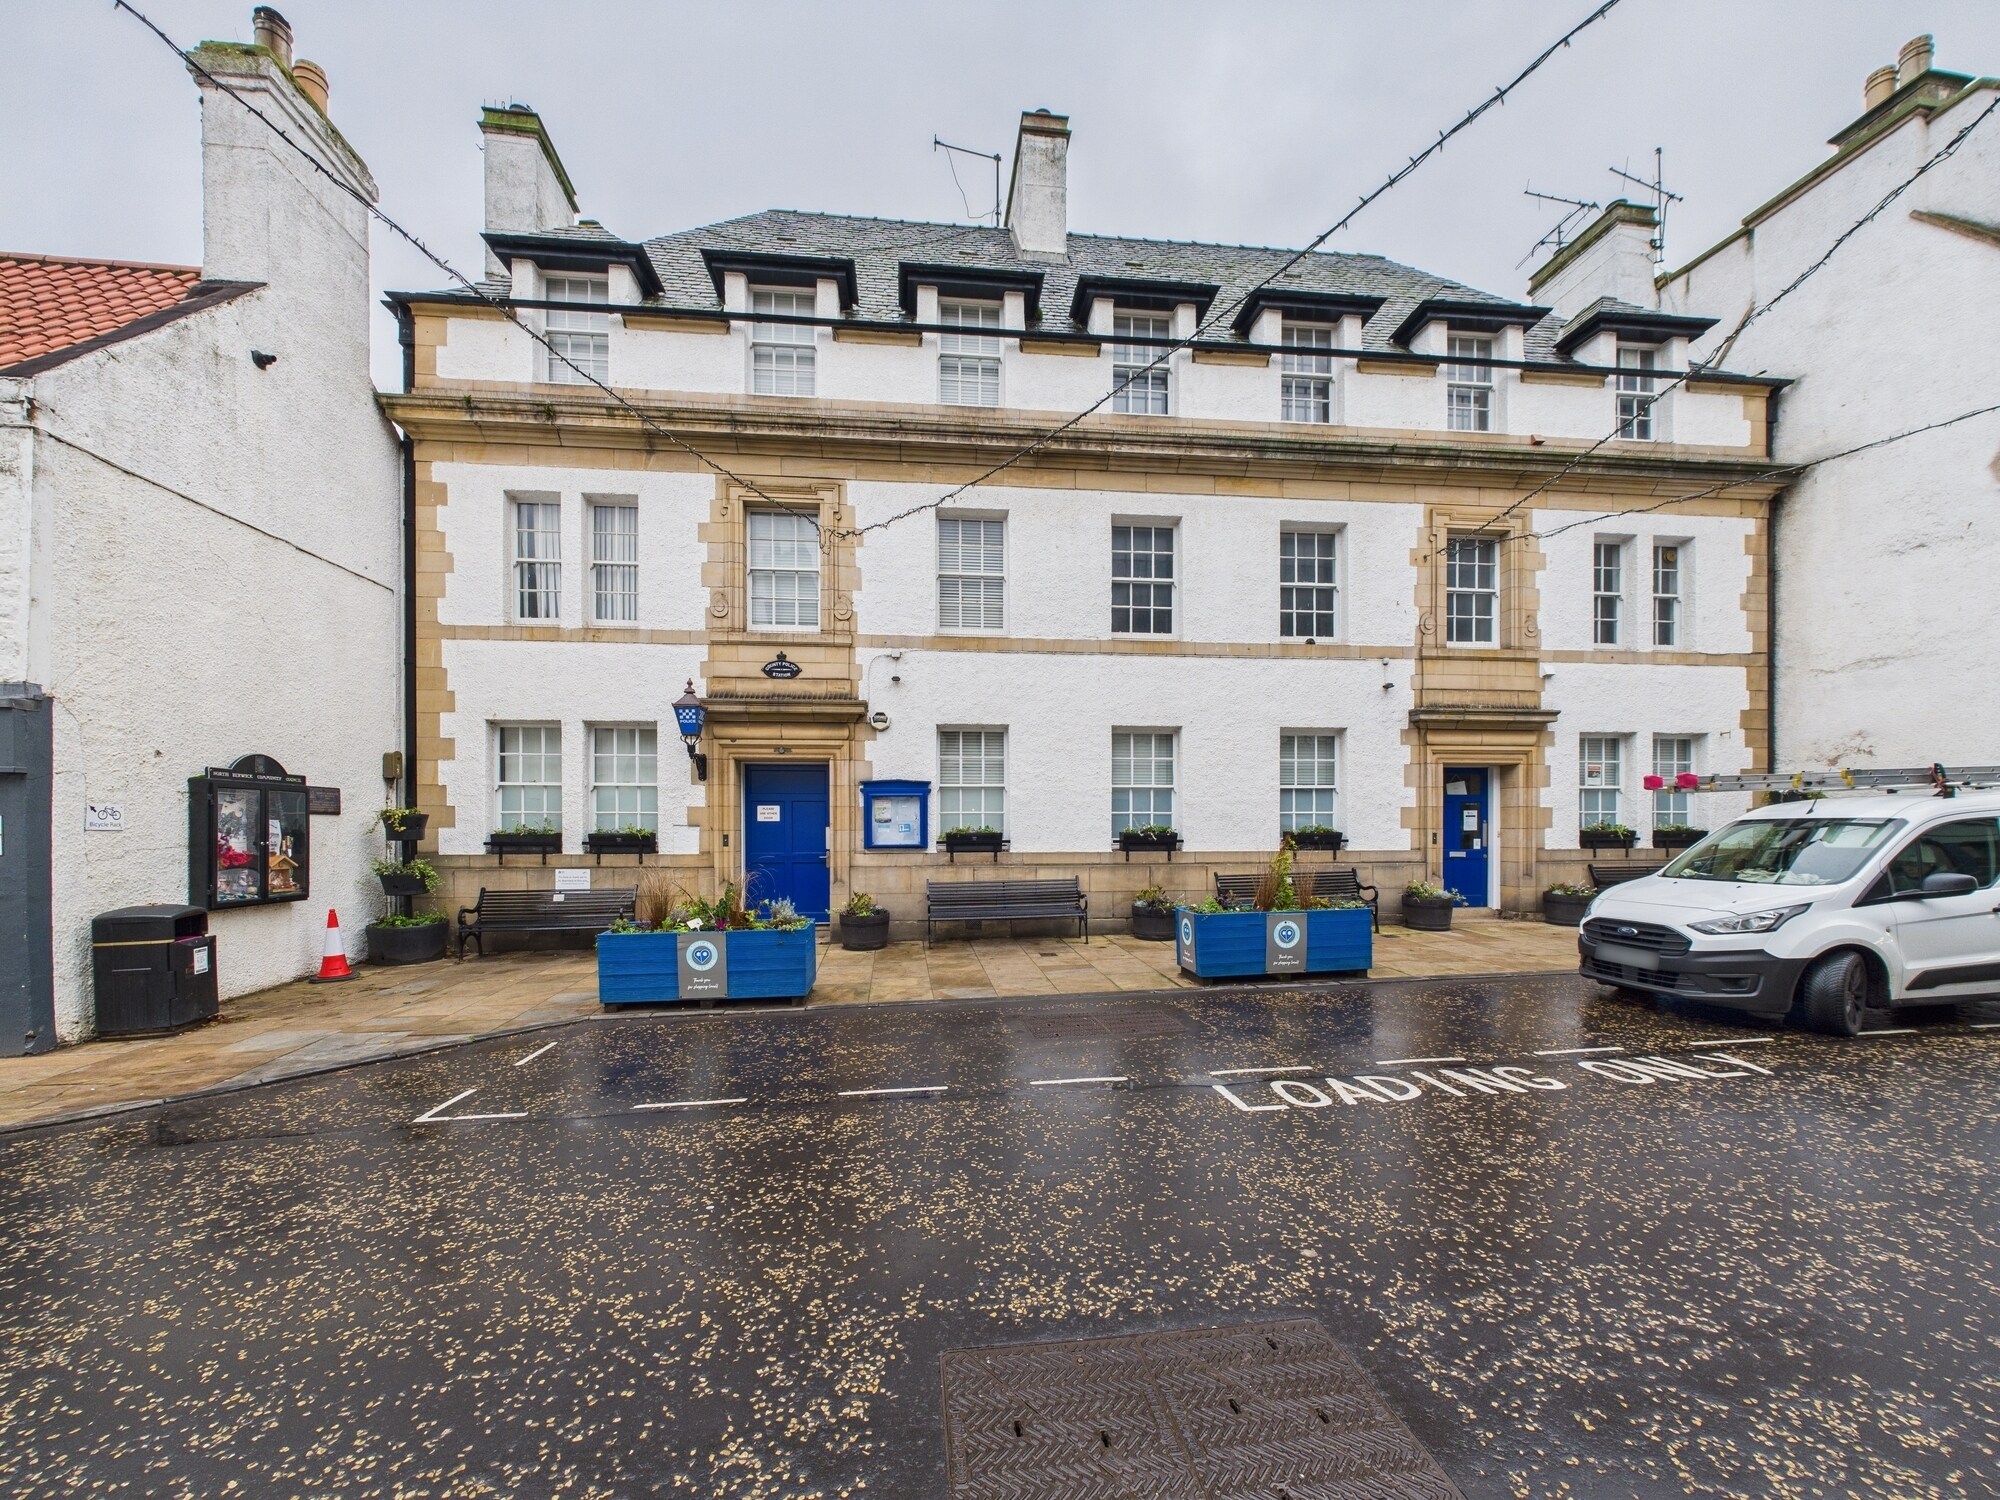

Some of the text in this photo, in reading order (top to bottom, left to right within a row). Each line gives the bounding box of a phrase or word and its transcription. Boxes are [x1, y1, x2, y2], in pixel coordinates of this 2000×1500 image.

[765, 662, 798, 671] COUNTY POLICE
[1212, 1053, 1774, 1112] LOADING ONLY
